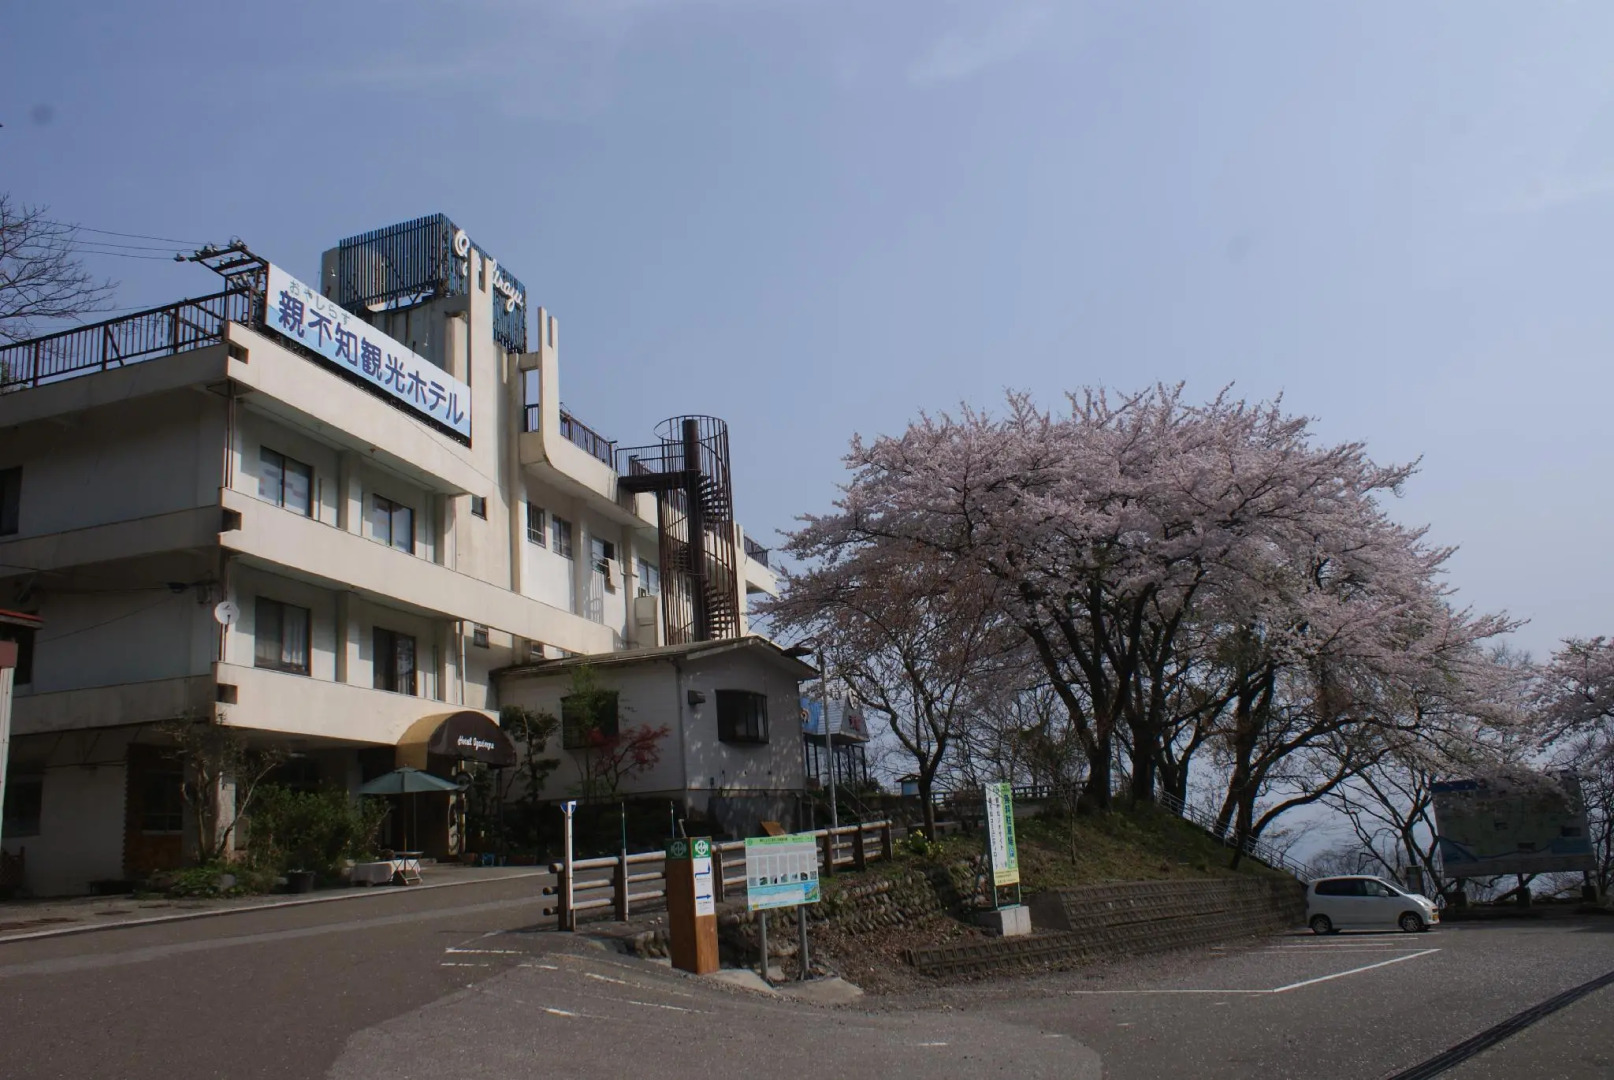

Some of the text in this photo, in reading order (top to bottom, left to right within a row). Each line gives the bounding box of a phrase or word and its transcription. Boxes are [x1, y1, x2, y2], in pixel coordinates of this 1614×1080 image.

[279, 290, 464, 424] 親不知観光ホテル
